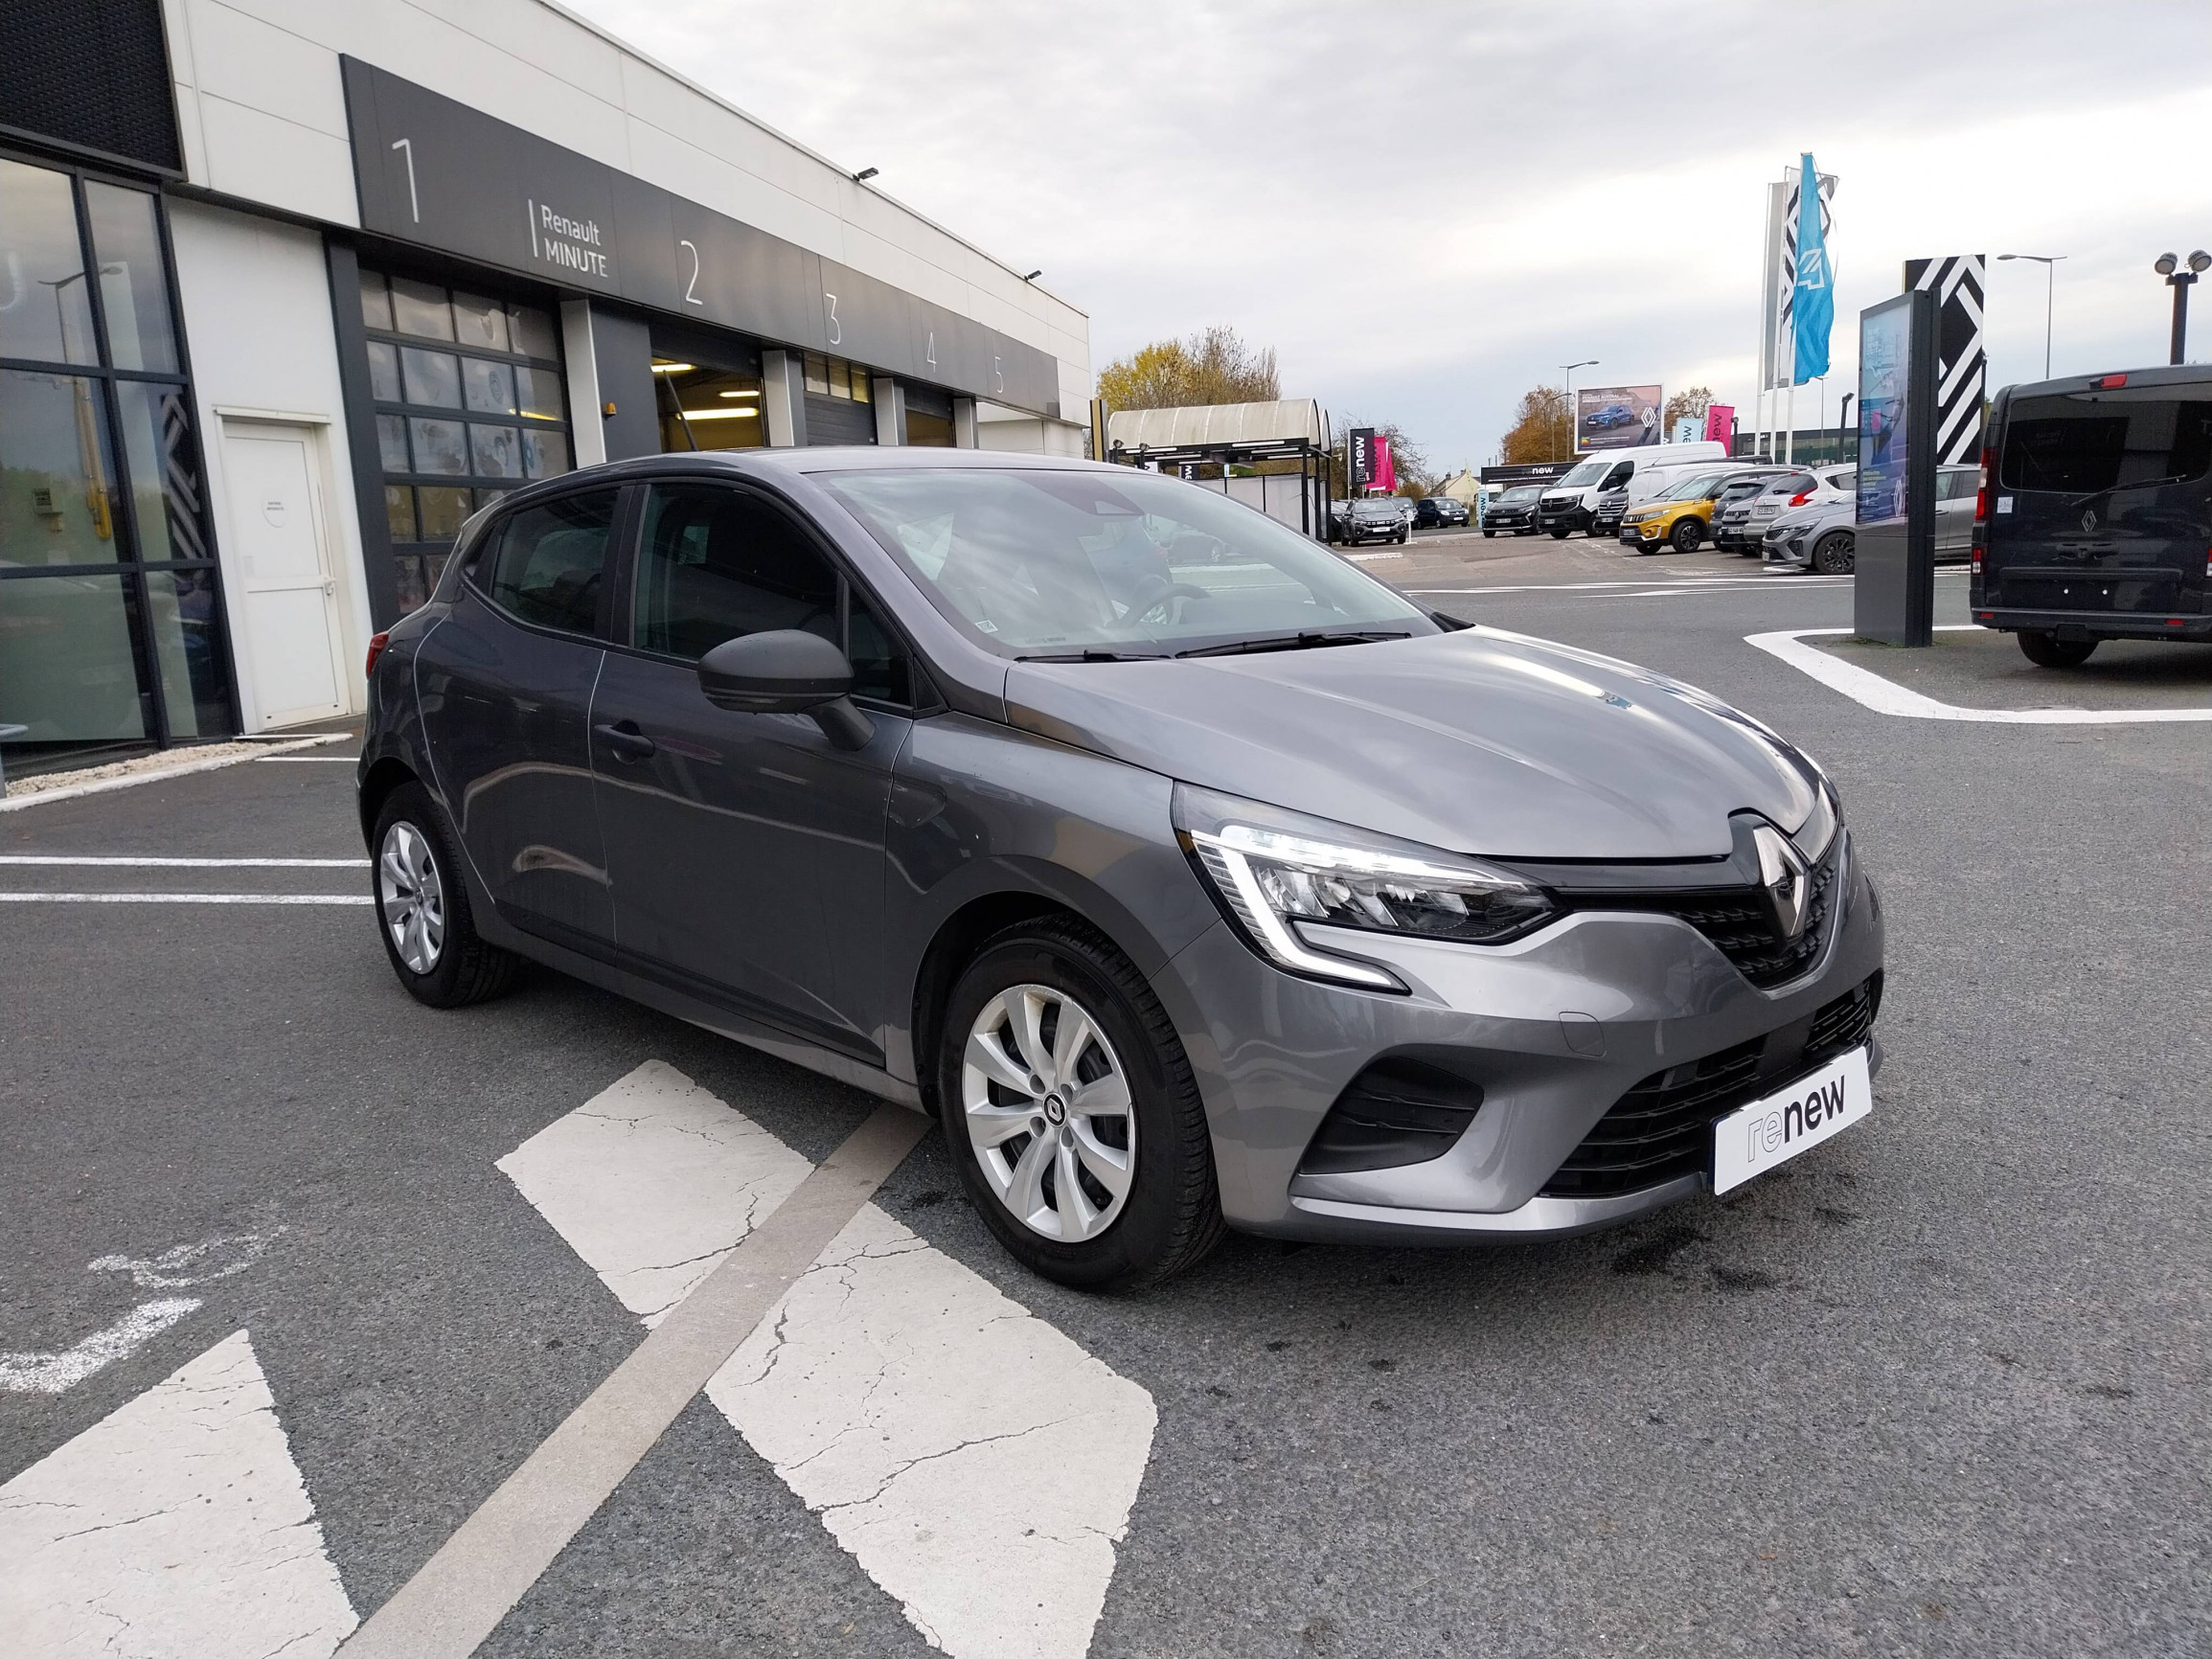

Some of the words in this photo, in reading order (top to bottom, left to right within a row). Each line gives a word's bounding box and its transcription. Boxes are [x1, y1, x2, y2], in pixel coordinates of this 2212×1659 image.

[392, 138, 419, 223] 1
[540, 204, 601, 246] Renault
[544, 238, 608, 278] MINUTE
[680, 240, 702, 305] 2
[826, 293, 841, 345] 3
[926, 331, 937, 373] 4
[994, 356, 1004, 394] 5
[1356, 436, 1365, 482] renew
[1747, 1075, 1845, 1163] renew
